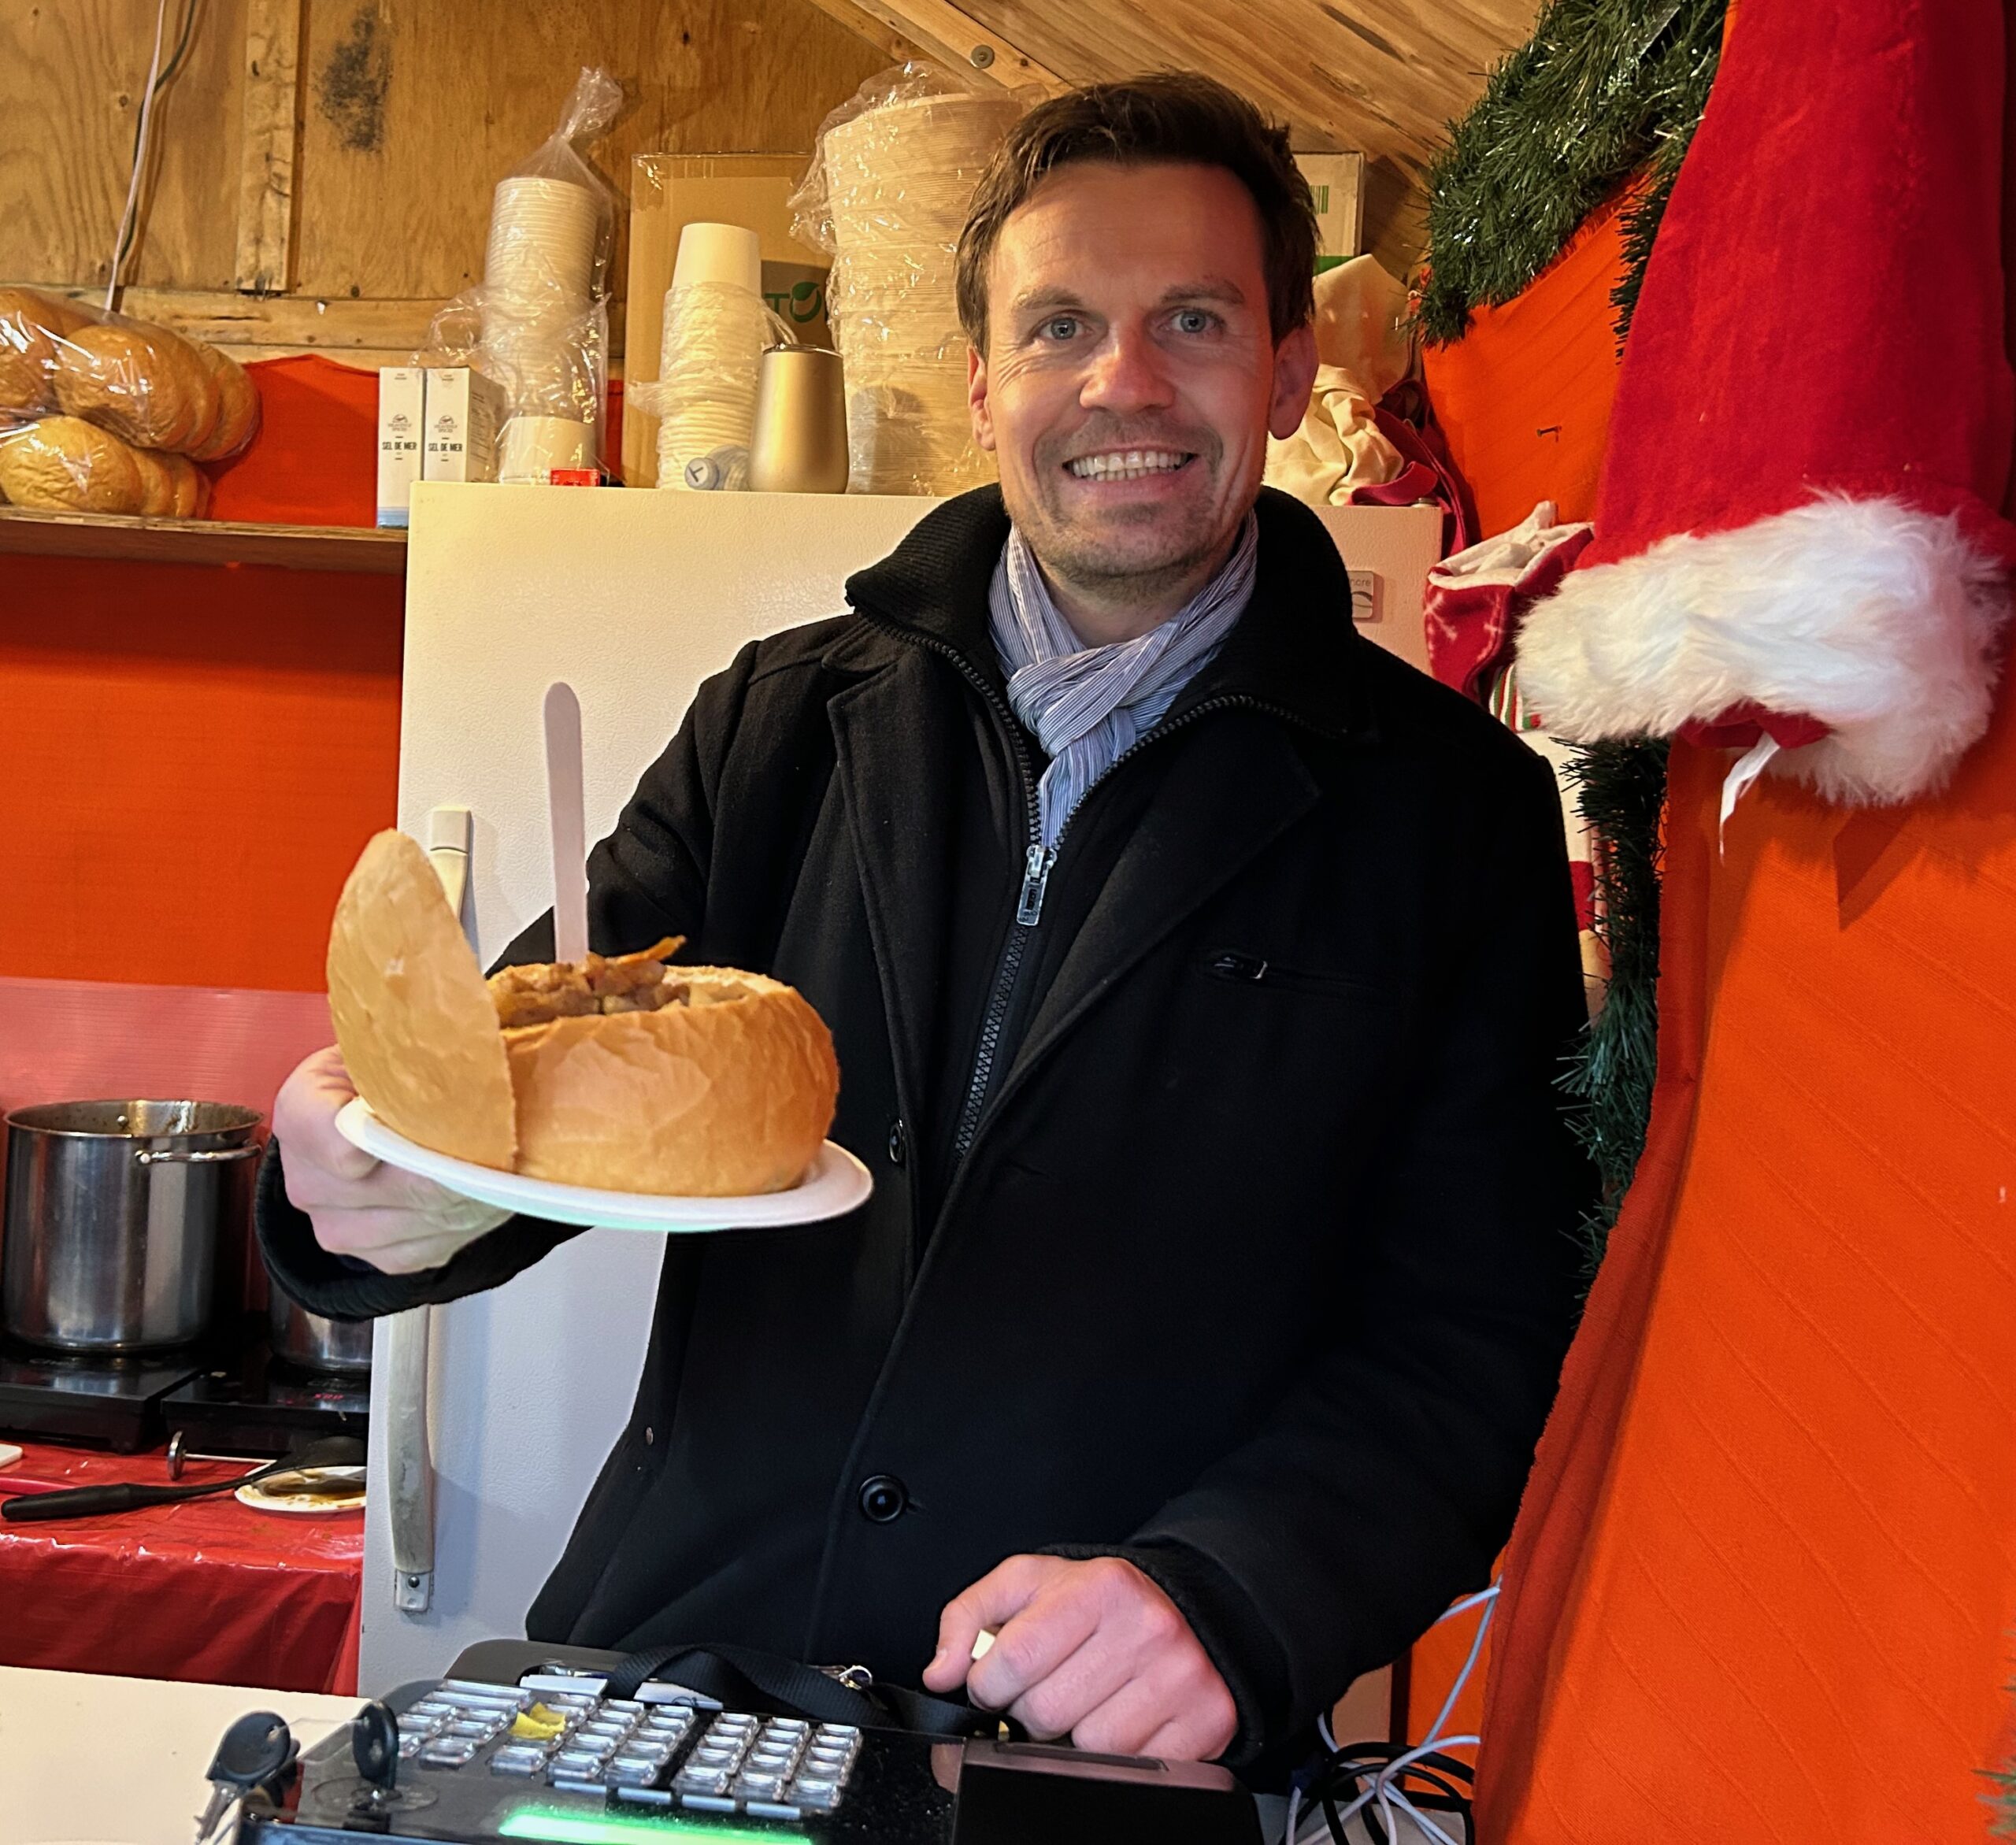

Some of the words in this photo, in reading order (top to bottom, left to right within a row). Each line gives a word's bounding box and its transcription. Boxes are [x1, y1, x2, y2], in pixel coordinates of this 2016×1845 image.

[382, 442, 392, 450] SEL
[395, 442, 402, 450] DE
[404, 442, 417, 450] MER
[428, 443, 439, 451] SEL
[440, 443, 448, 451] DE
[450, 443, 463, 451] MER
